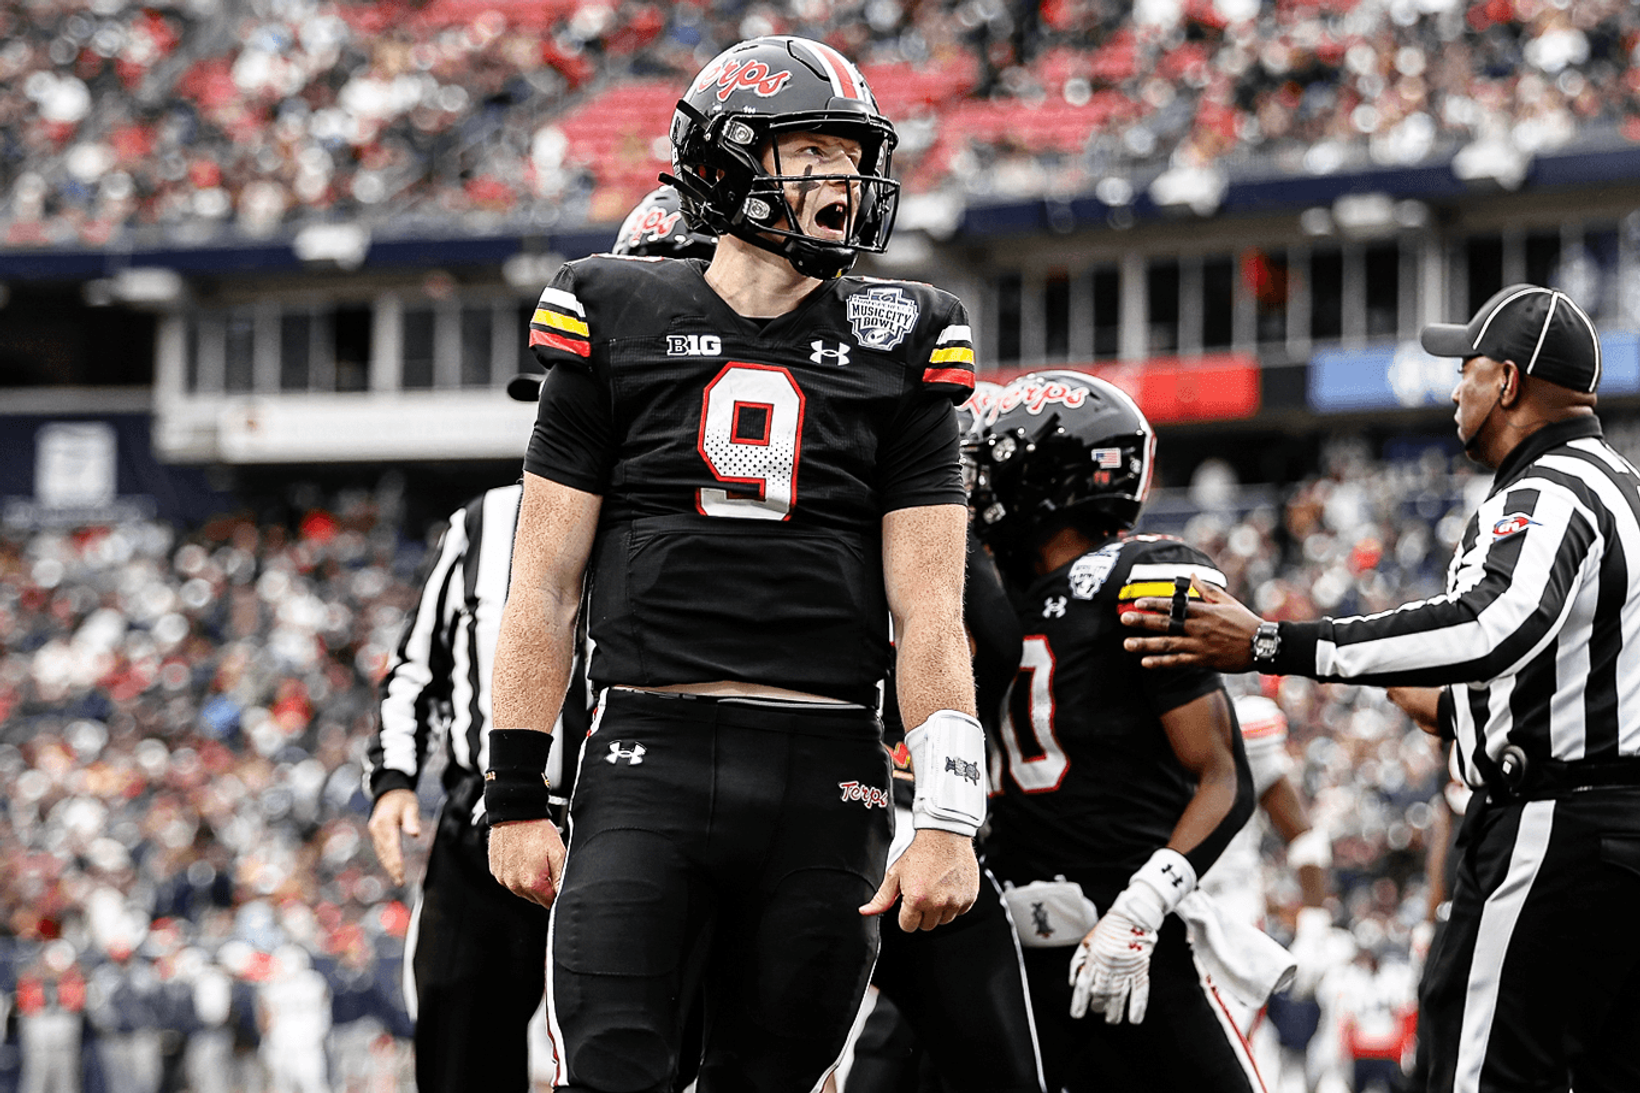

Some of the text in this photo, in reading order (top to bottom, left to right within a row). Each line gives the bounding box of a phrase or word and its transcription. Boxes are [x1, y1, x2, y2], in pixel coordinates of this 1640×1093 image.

[698, 59, 791, 102] erps
[852, 303, 885, 318] MUSIC
[886, 310, 912, 326] CITY
[864, 317, 894, 332] BOWL
[695, 361, 806, 521] 9
[839, 780, 888, 809] Terps
